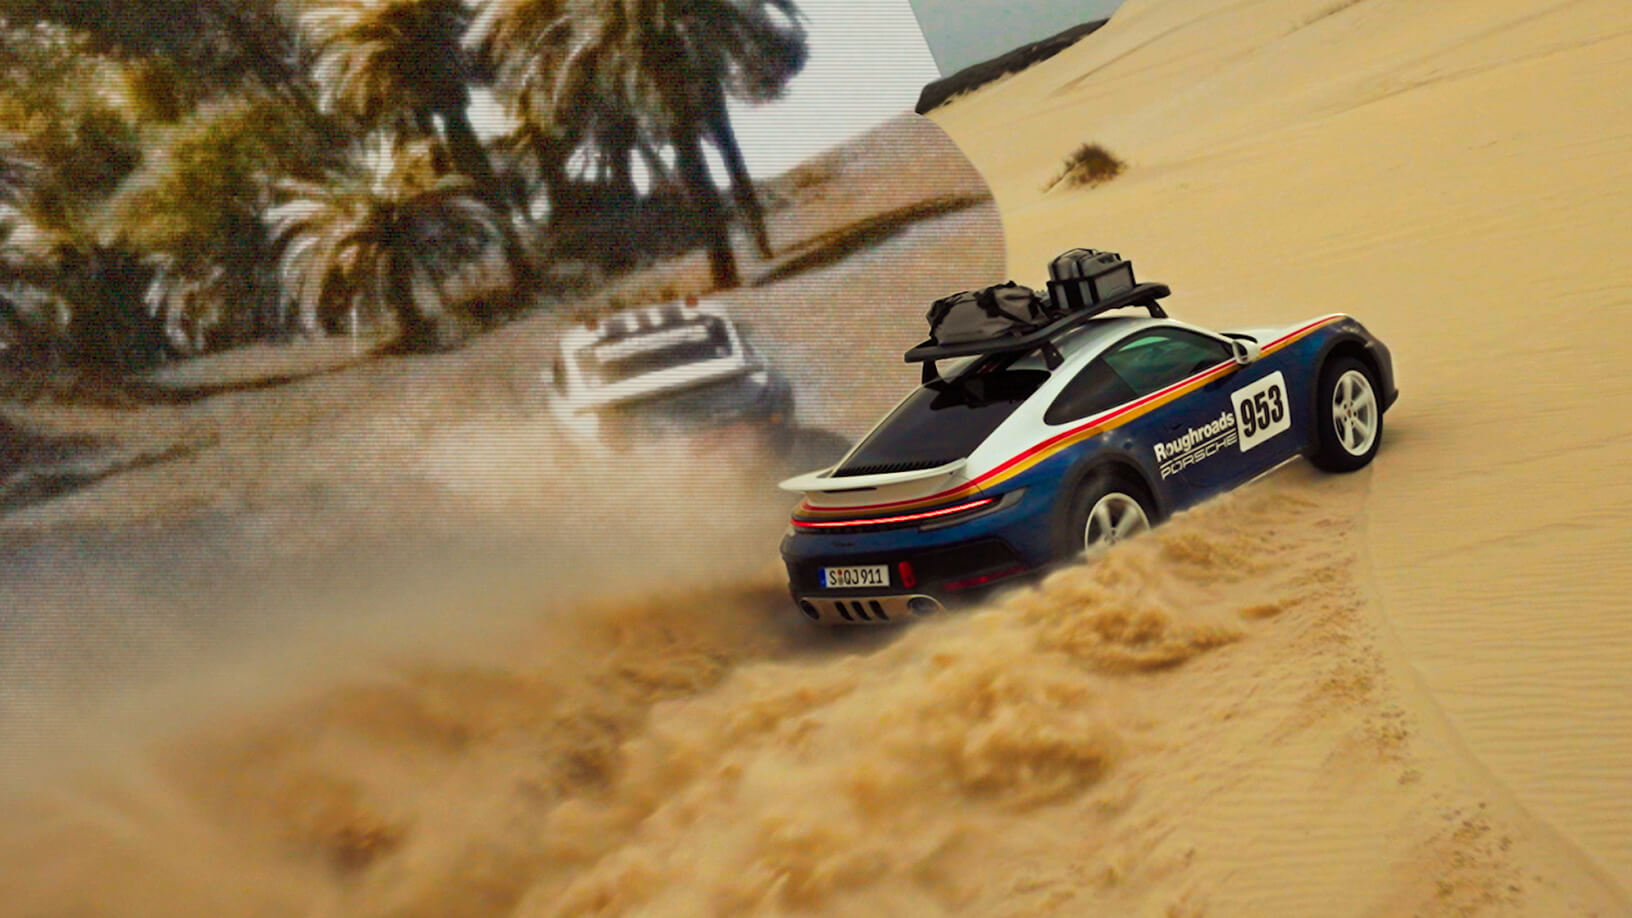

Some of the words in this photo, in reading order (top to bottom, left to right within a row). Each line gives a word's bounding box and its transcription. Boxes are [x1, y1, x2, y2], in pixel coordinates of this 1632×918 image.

[1240, 384, 1284, 437] 953
[1153, 412, 1235, 462] Roughroads
[1160, 432, 1238, 480] PORSCHE
